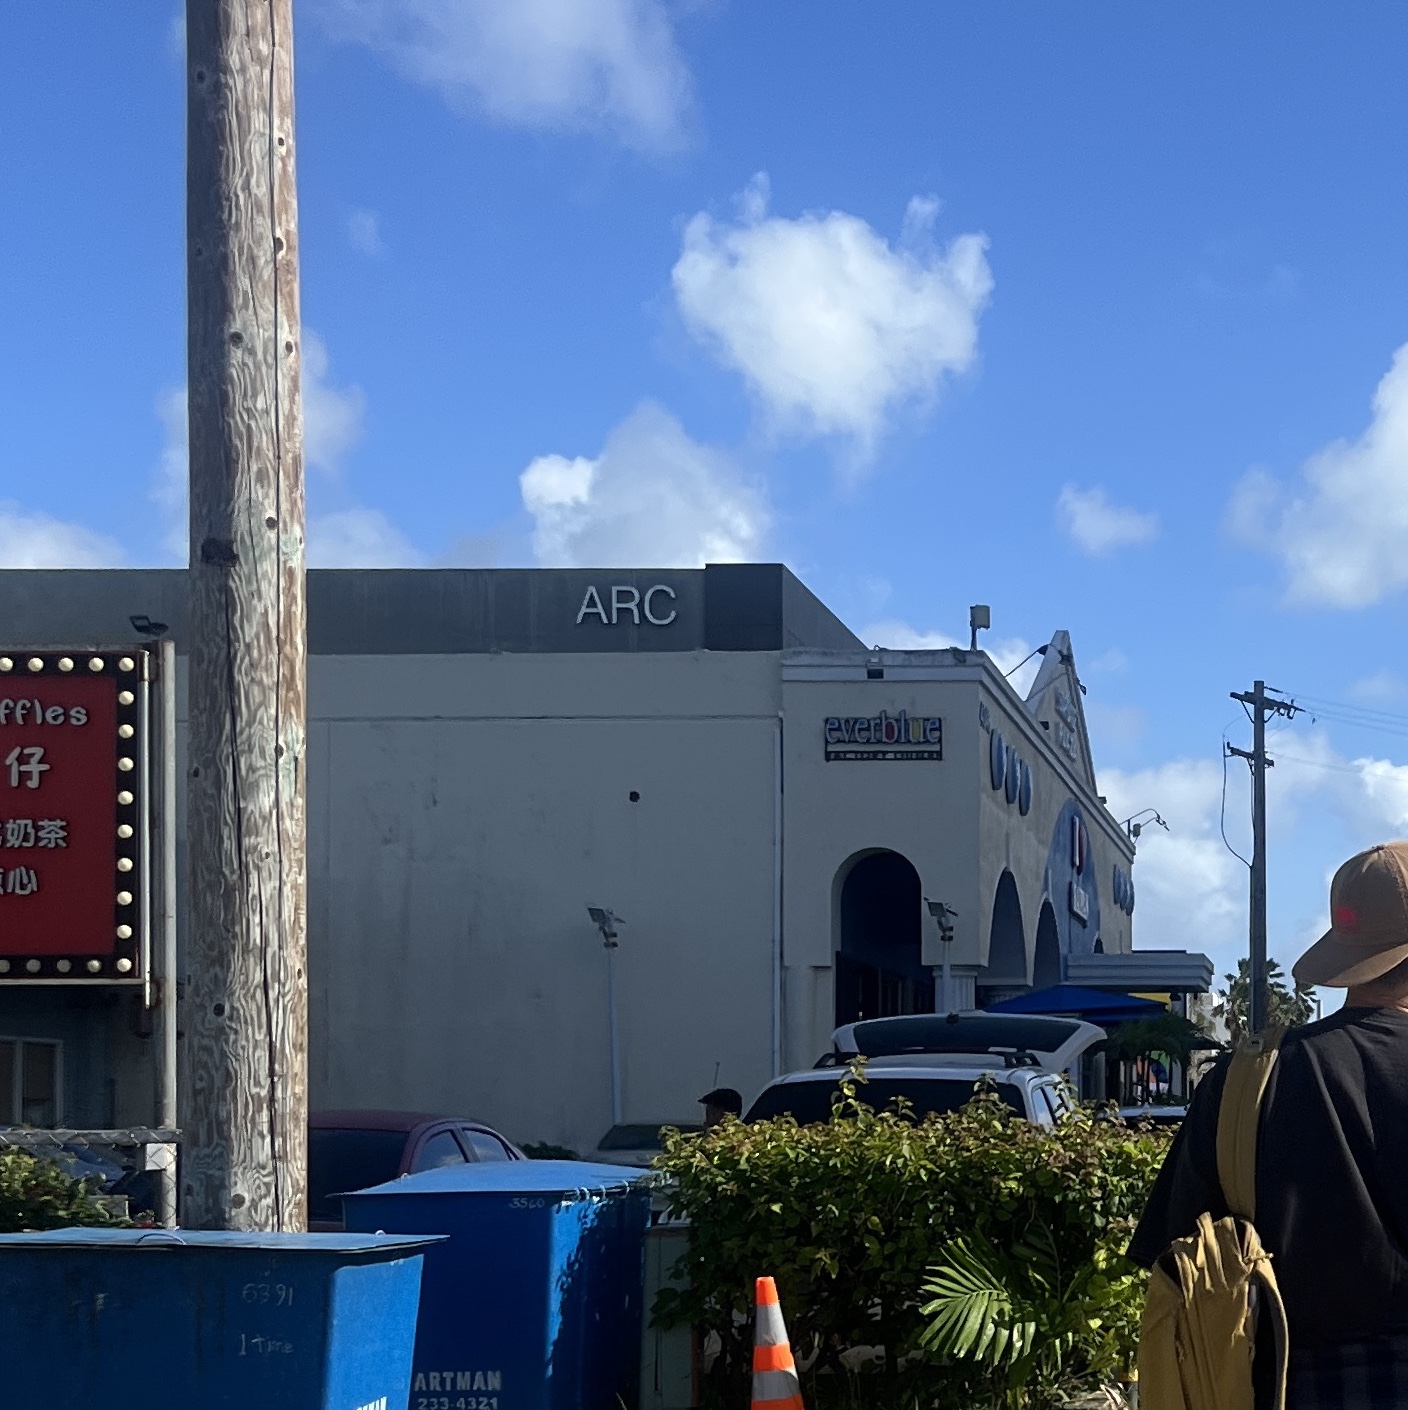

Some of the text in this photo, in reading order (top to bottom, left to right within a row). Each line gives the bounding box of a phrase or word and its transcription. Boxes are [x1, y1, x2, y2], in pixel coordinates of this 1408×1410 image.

[576, 584, 677, 625] ARC
[826, 709, 942, 744] everblue
[5, 746, 50, 789] 仔
[0, 818, 68, 848] 奶茶
[414, 1370, 502, 1392] ARTMAN
